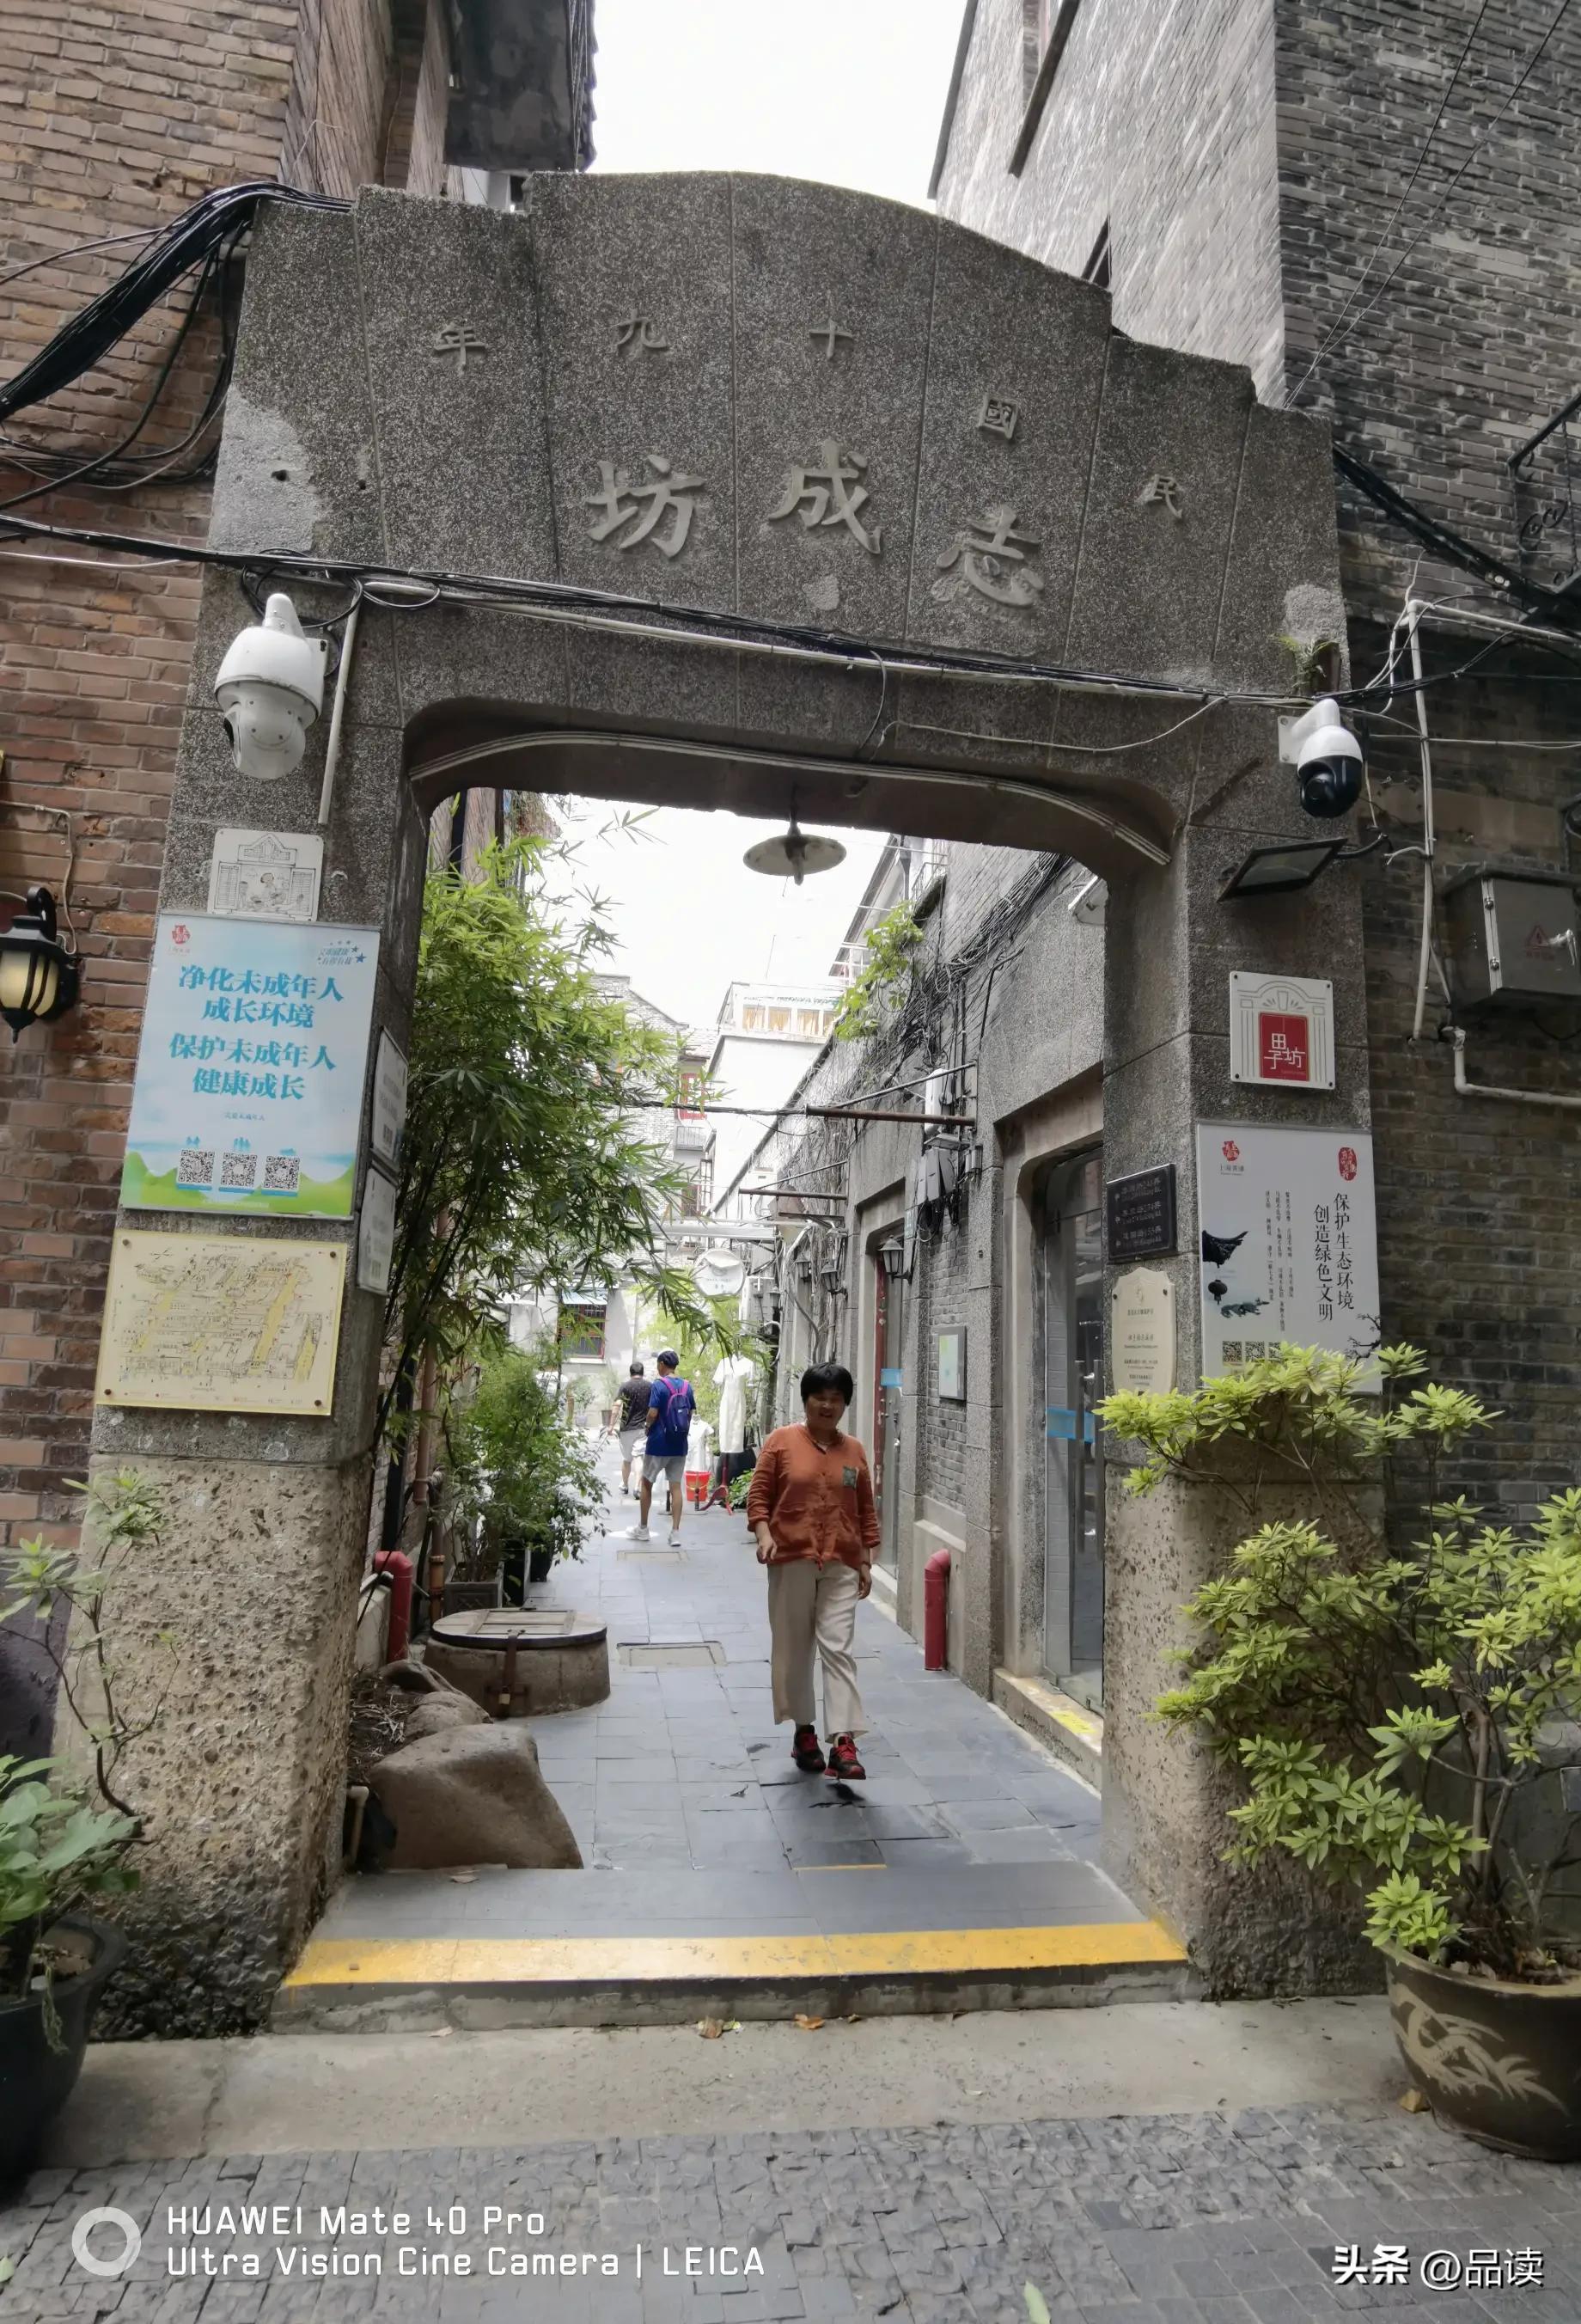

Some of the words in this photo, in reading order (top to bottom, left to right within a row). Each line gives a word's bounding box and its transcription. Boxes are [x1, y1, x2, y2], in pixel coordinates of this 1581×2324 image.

[179, 964, 344, 1002] 净化未成年人
[201, 996, 315, 1029] 成长环境
[169, 1033, 337, 1071] 保护未成年人
[192, 1067, 305, 1100] 健康成长
[1313, 1204, 1334, 1322] 创造绿色文明
[1334, 1192, 1355, 1310] 保护生态环境
